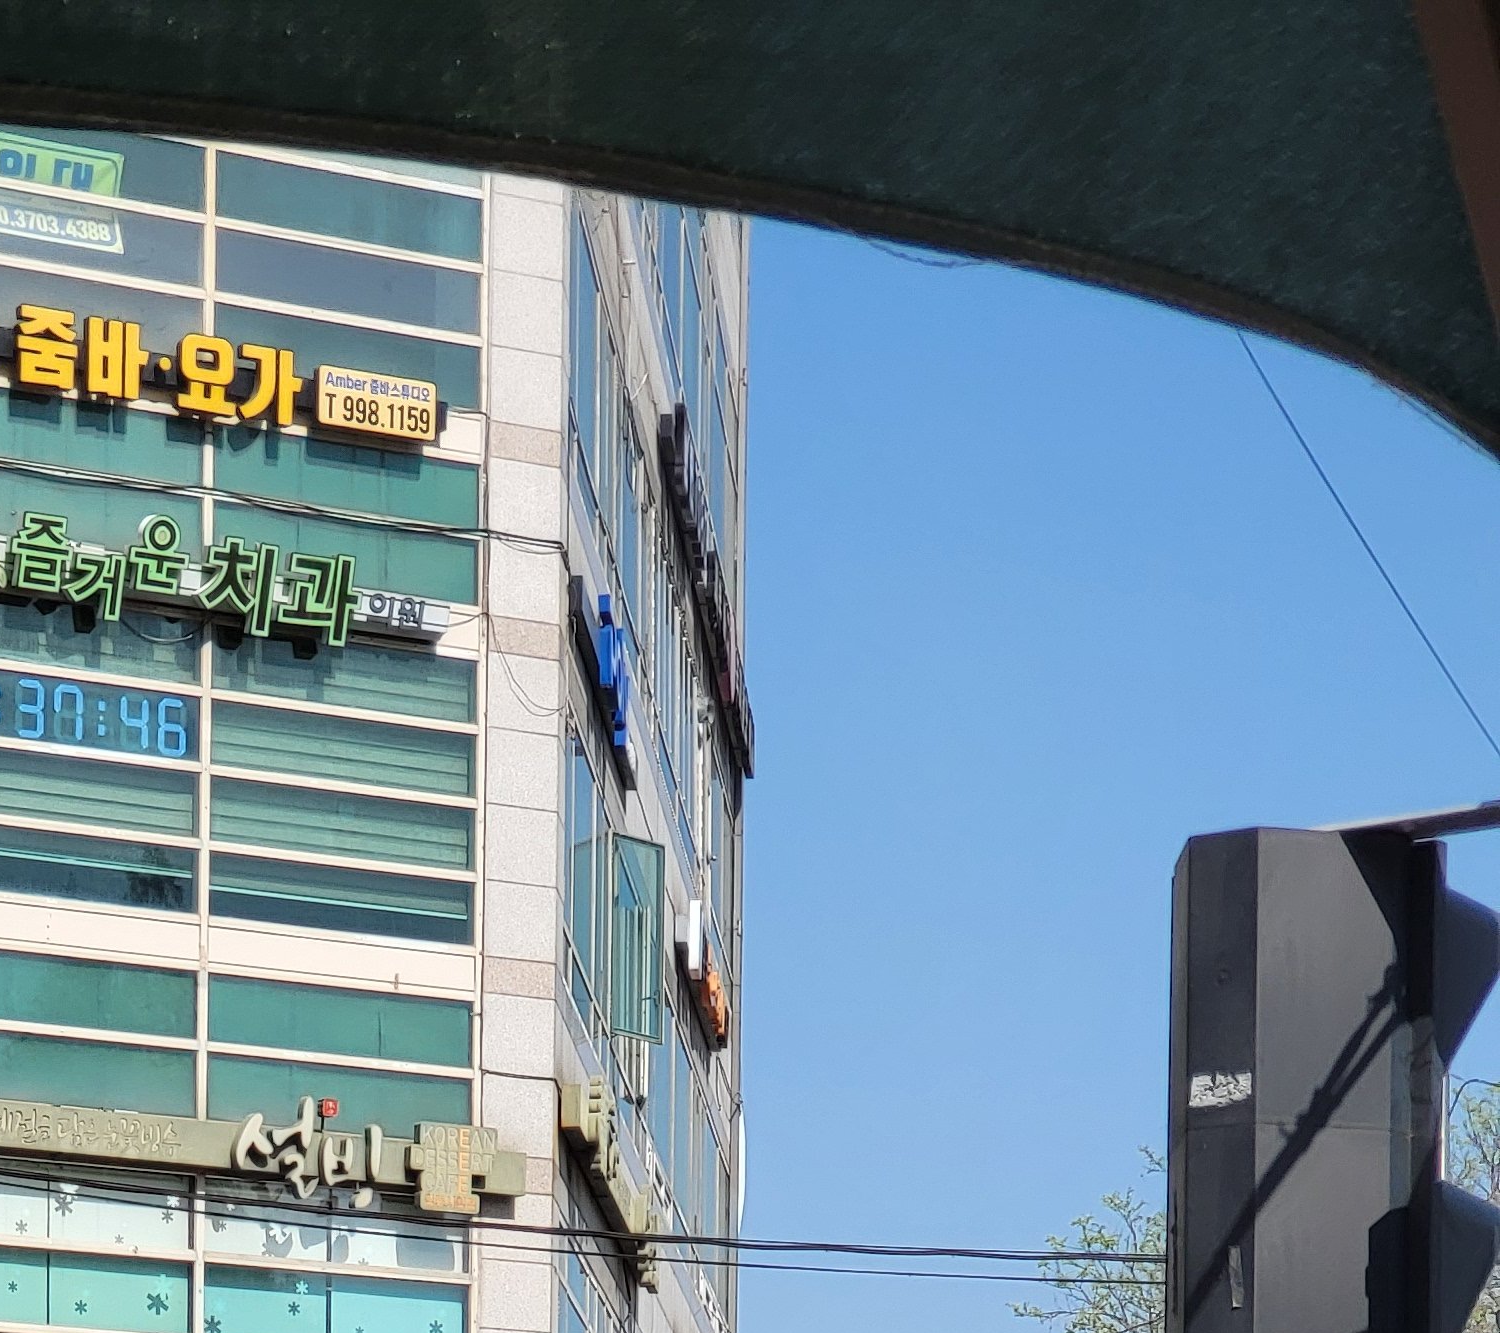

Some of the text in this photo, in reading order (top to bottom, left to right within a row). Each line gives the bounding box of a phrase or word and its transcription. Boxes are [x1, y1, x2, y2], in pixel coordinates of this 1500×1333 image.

[325, 371, 368, 391] Amber
[325, 393, 430, 434] T 998.1159
[366, 592, 426, 630] 의원
[235, 1095, 383, 1209] 설빙
[421, 1126, 498, 1151] KOREAN
[413, 1147, 495, 1174] DESSERT
[423, 1172, 469, 1194] CAFE
